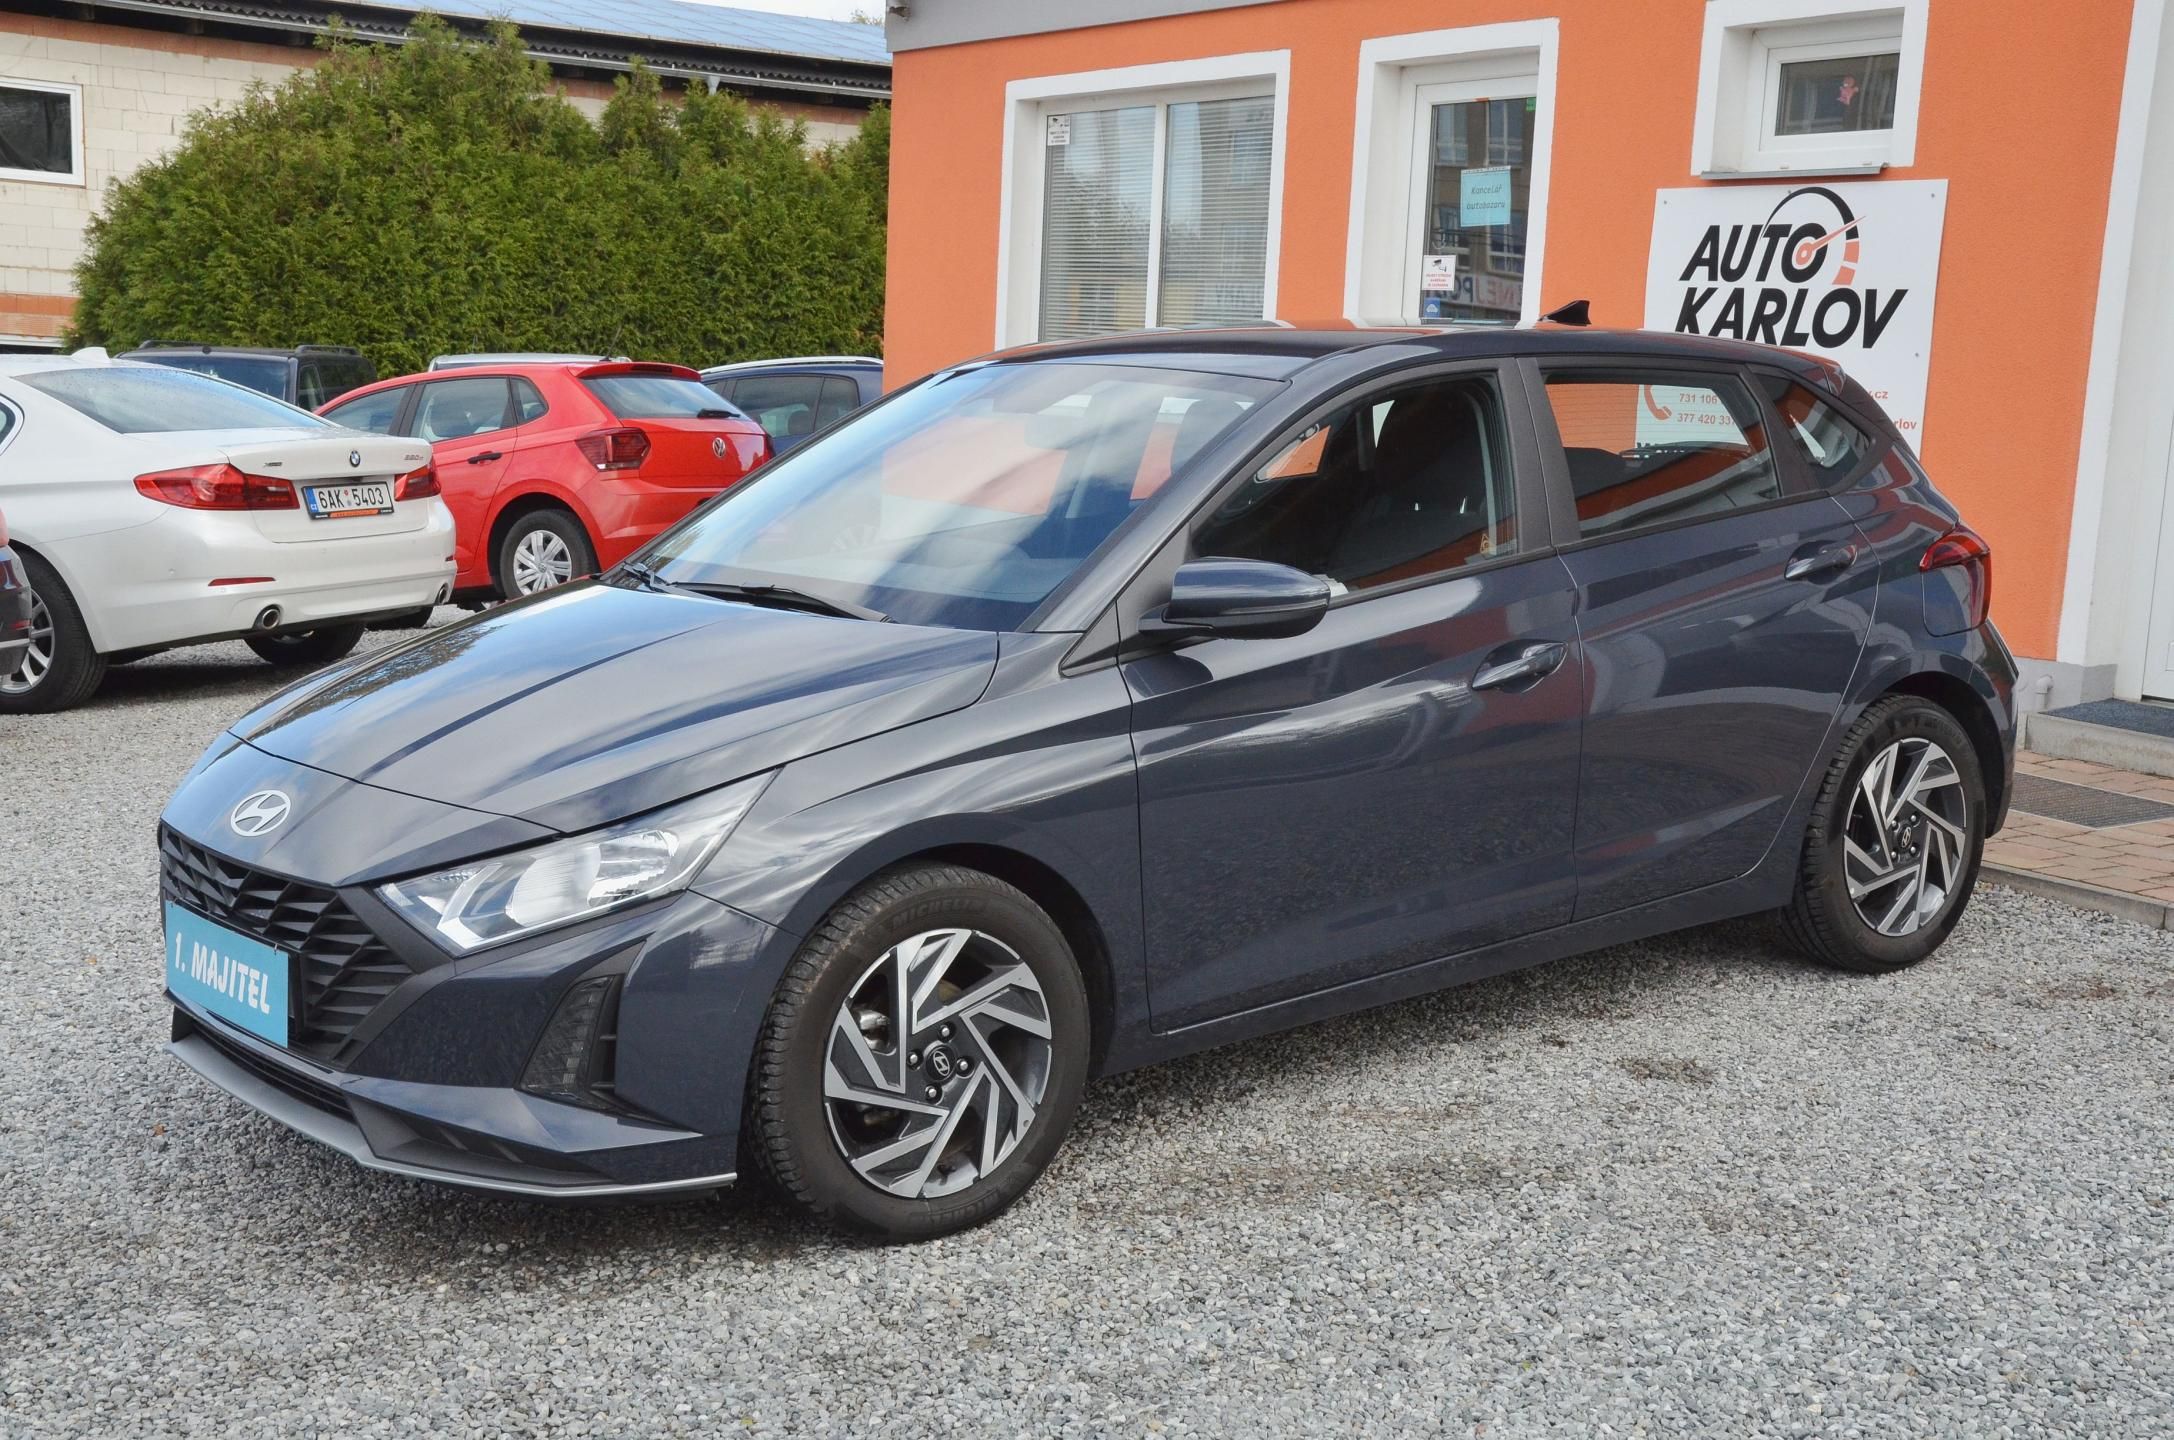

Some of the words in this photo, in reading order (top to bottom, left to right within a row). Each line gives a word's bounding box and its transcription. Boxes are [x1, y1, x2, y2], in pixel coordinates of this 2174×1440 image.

[1679, 222, 1829, 283] AUTO
[1675, 287, 1909, 349] KARLOV
[1677, 412, 1695, 423] 377
[1698, 414, 1716, 425] 420
[1718, 416, 1735, 425] 33
[1679, 393, 1696, 403] 731
[1700, 394, 1718, 404] 106
[318, 488, 346, 509] 6AK
[352, 487, 384, 507] 5403
[175, 932, 186, 973] 1.
[191, 941, 270, 1015] MAJITEL
